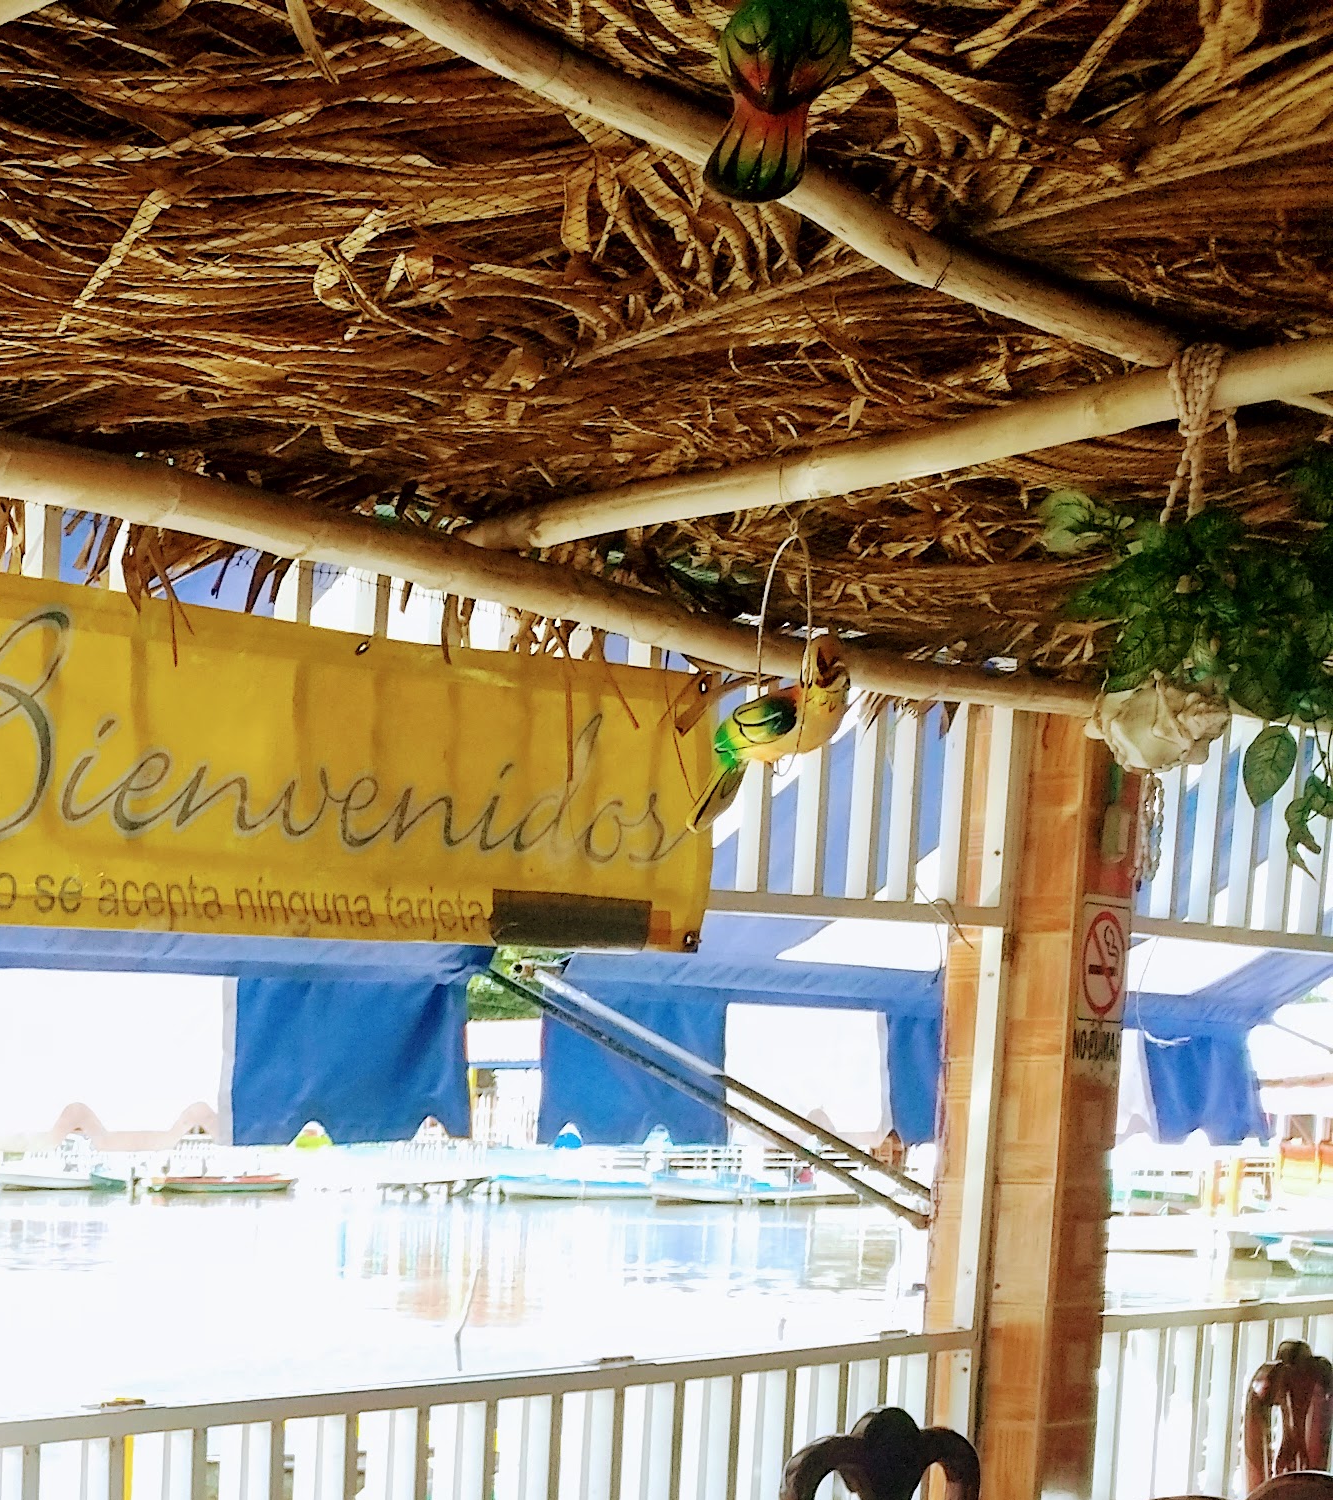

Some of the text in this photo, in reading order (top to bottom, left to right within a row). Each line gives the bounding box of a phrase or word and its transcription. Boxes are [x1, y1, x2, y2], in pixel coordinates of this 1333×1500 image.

[33, 873, 83, 914] se
[97, 873, 224, 932] acepta
[234, 876, 375, 938] ninguna
[383, 885, 491, 941] tarjeta
[1072, 1029, 1087, 1060] NO
